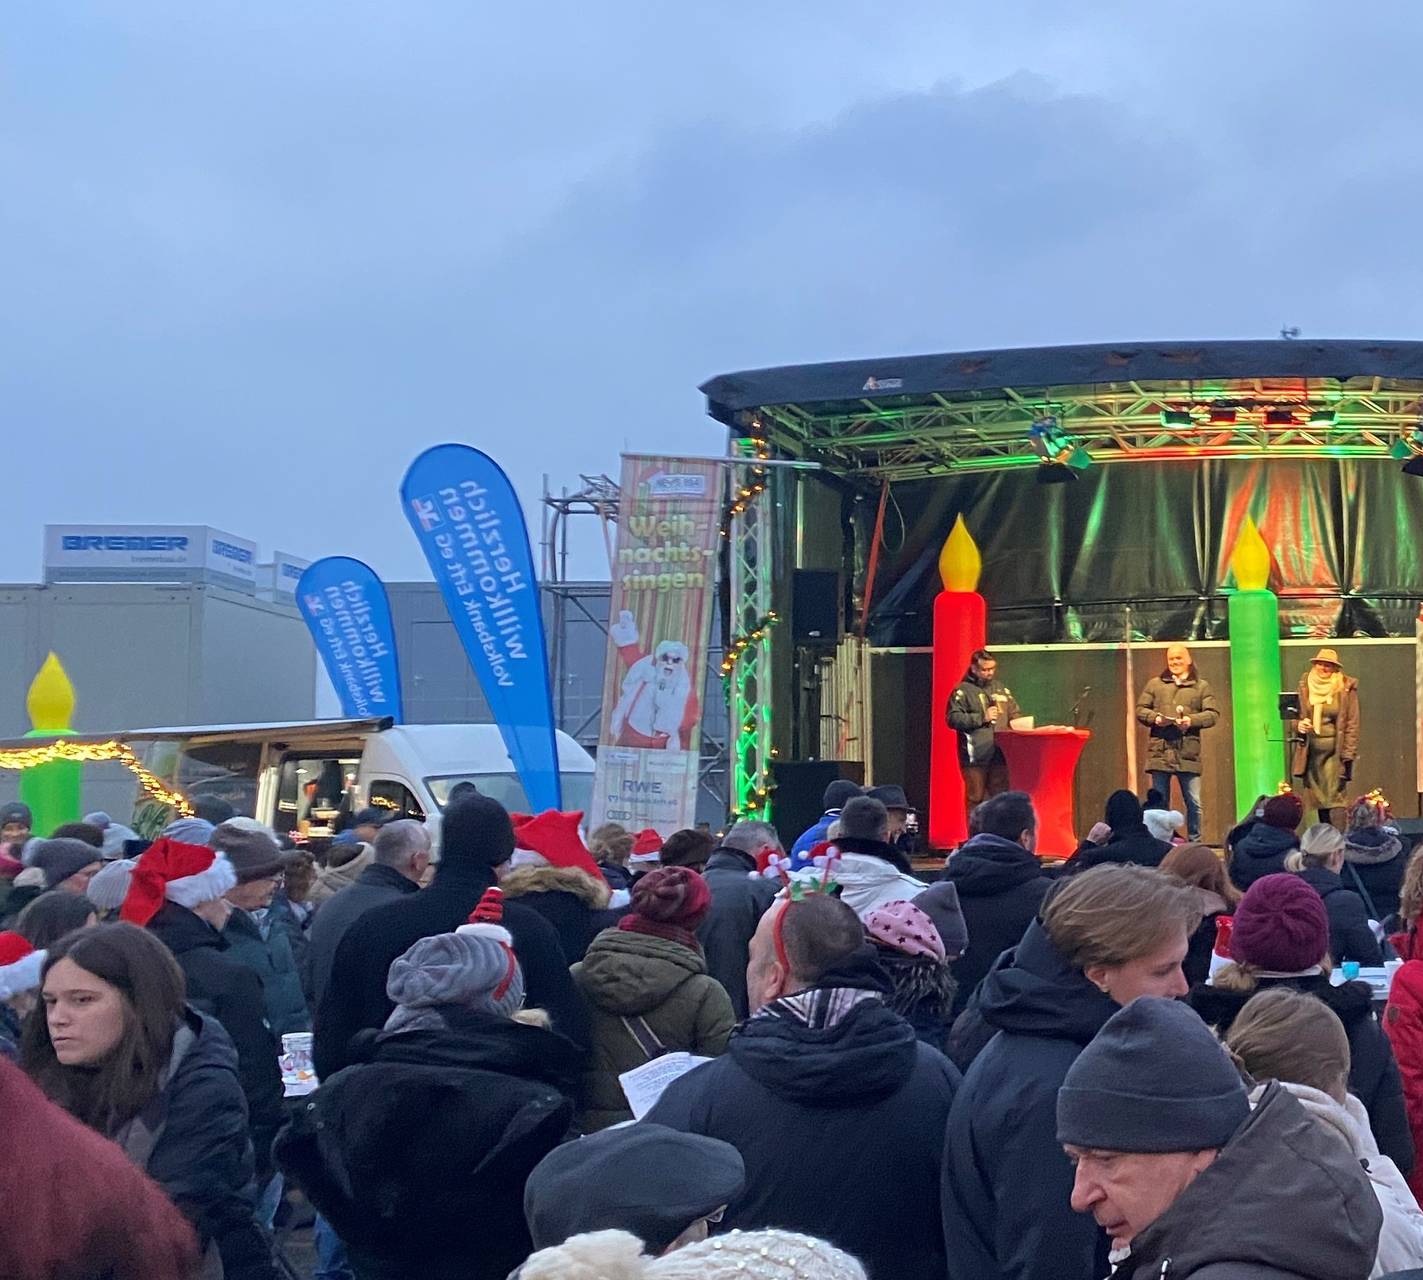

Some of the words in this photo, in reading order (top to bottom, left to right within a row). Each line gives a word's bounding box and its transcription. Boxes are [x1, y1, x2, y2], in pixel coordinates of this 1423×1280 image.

[629, 514, 708, 537] Weih-
[62, 535, 188, 550] BREMER
[619, 541, 714, 562] nachts-
[622, 569, 704, 593] singen
[623, 780, 662, 794] RWE
